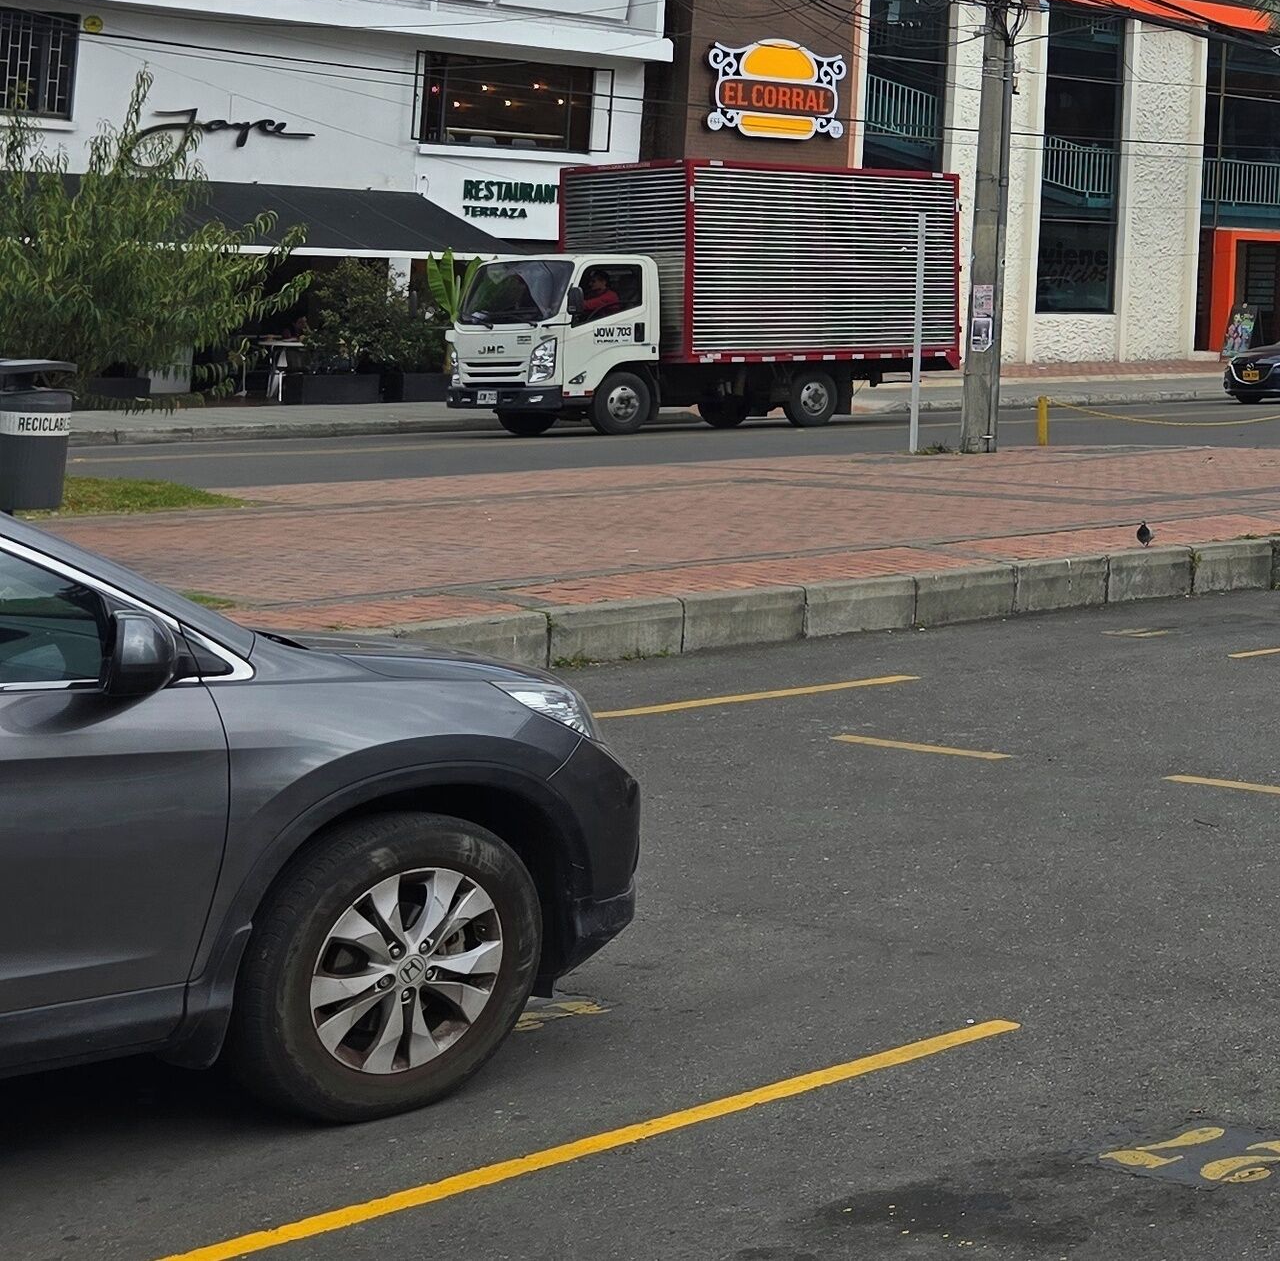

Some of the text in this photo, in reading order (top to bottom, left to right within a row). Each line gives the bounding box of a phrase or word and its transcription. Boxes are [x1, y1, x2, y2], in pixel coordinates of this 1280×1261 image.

[723, 82, 829, 112] EL CORRAL
[462, 205, 528, 219] TERRAZA
[594, 326, 632, 337] JOW 703
[478, 345, 505, 355] JMC
